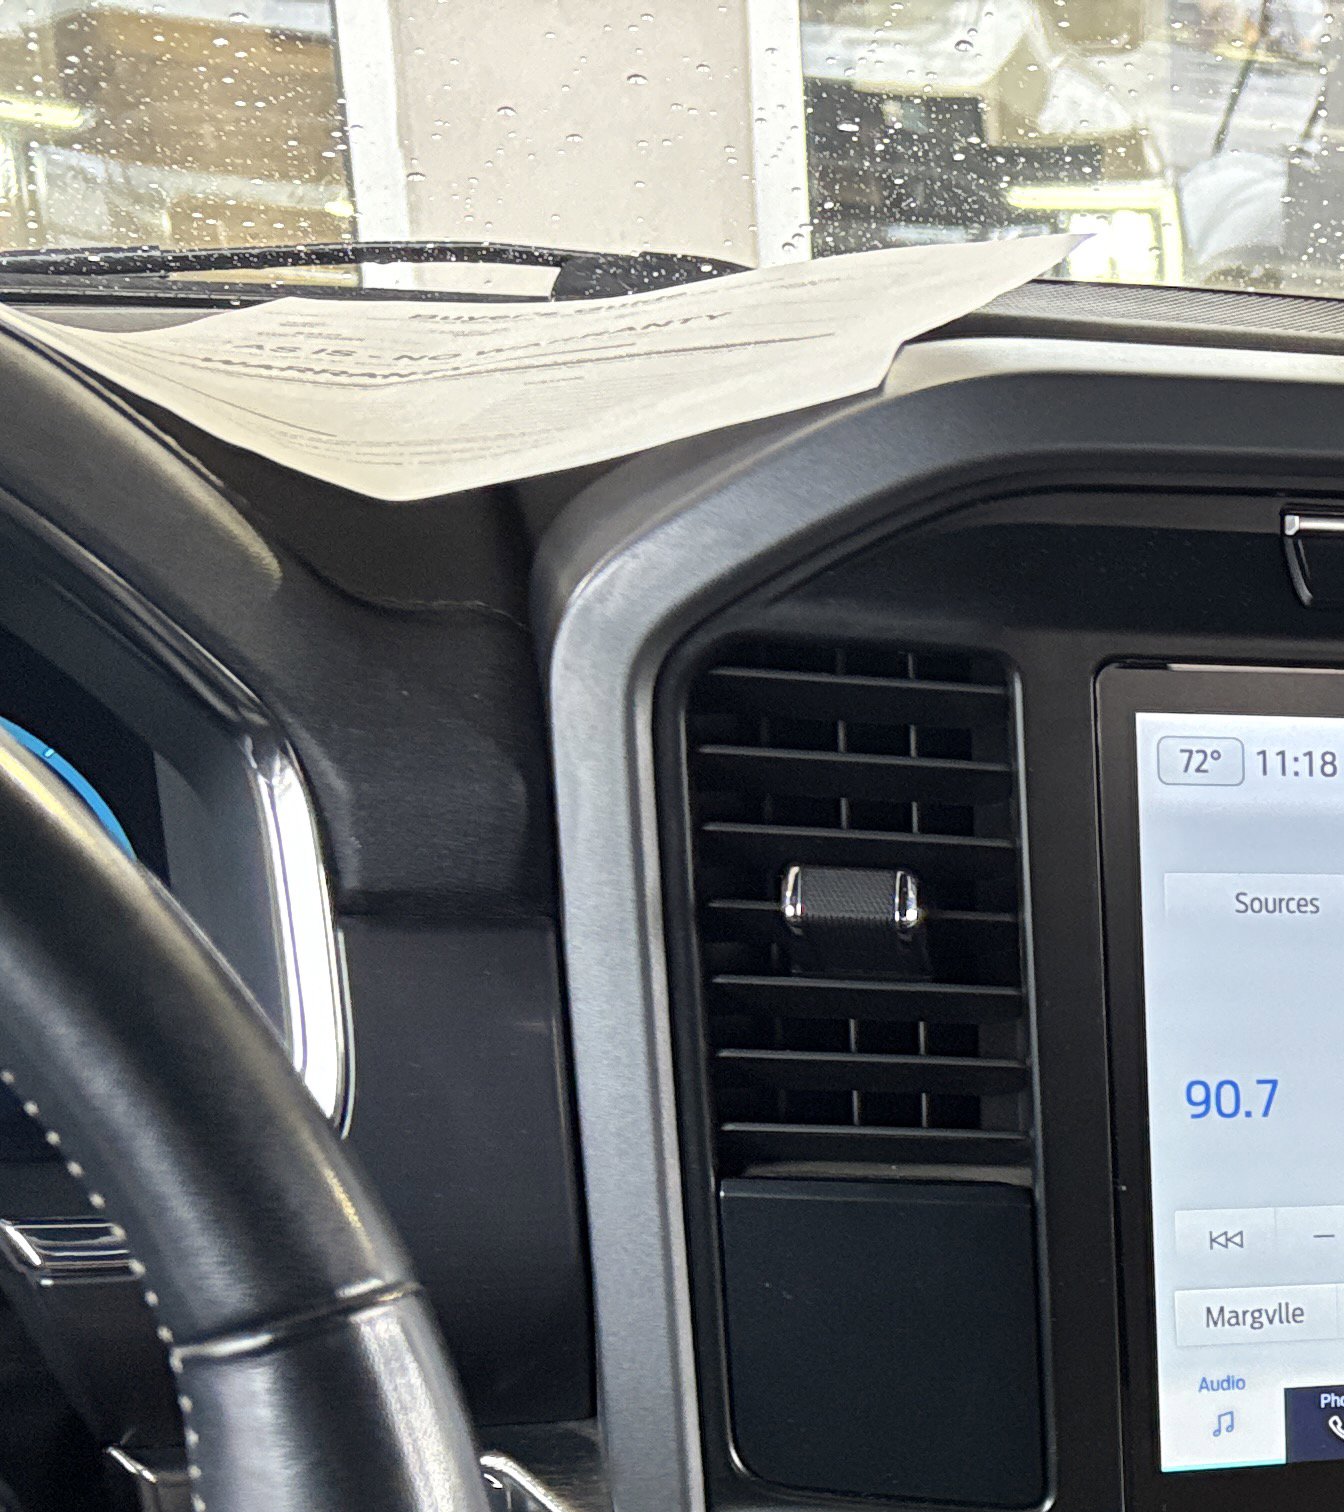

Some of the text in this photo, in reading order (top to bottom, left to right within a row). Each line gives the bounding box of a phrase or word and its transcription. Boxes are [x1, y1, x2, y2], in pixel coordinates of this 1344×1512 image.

[1179, 748, 1338, 778] 72° 11:18
[1235, 891, 1320, 915] Sources
[1185, 1078, 1279, 1120] 90.7
[1206, 1301, 1305, 1331] Margvlle
[1198, 1374, 1246, 1393] Audio
